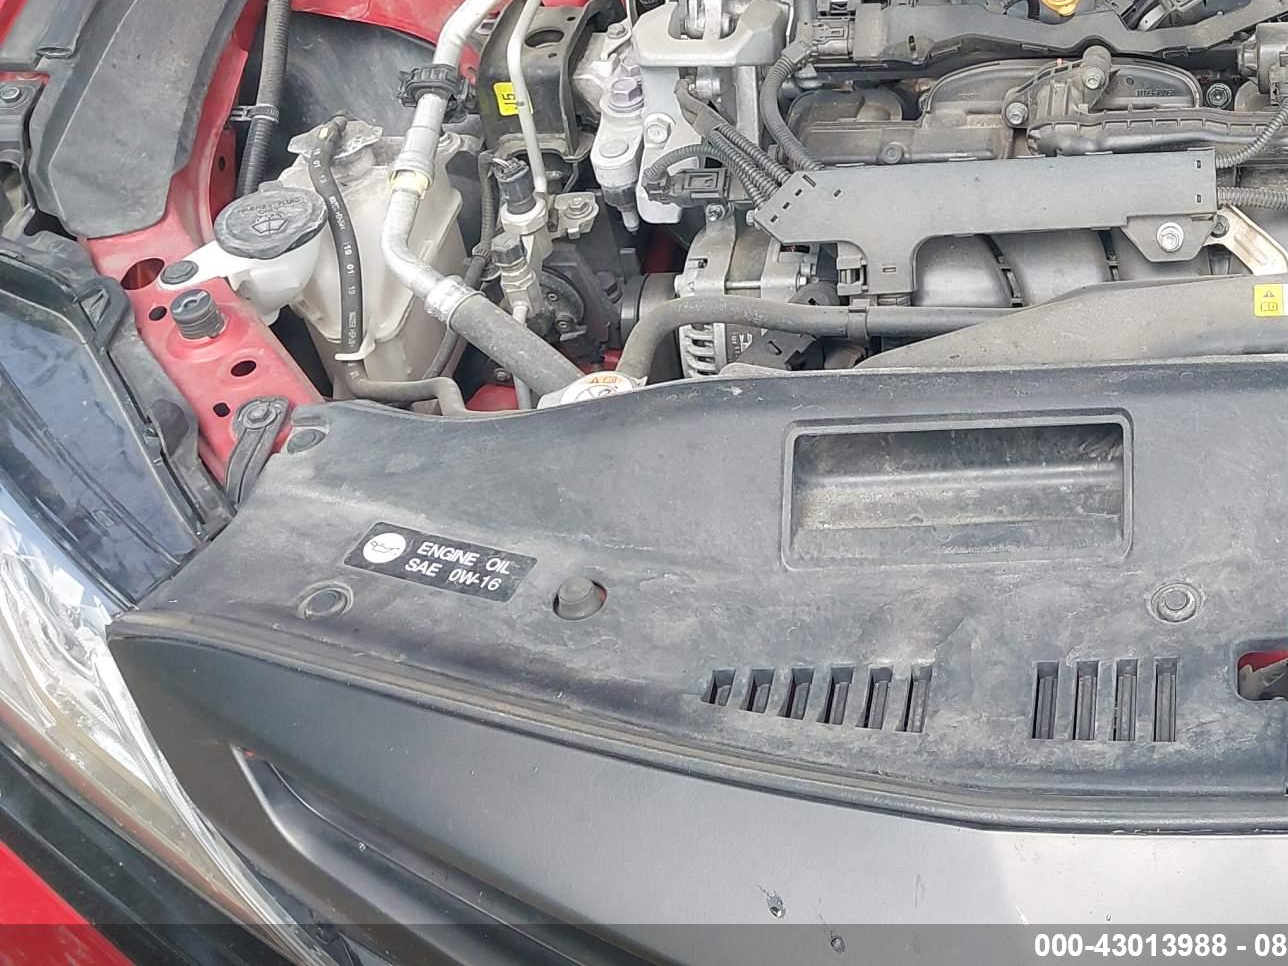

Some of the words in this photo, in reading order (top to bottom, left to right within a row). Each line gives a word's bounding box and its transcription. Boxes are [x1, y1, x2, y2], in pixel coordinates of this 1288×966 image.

[404, 557, 443, 578] SAE
[448, 568, 502, 591] 0W-16
[416, 541, 480, 567] ENGINE
[485, 557, 511, 575] OIL
